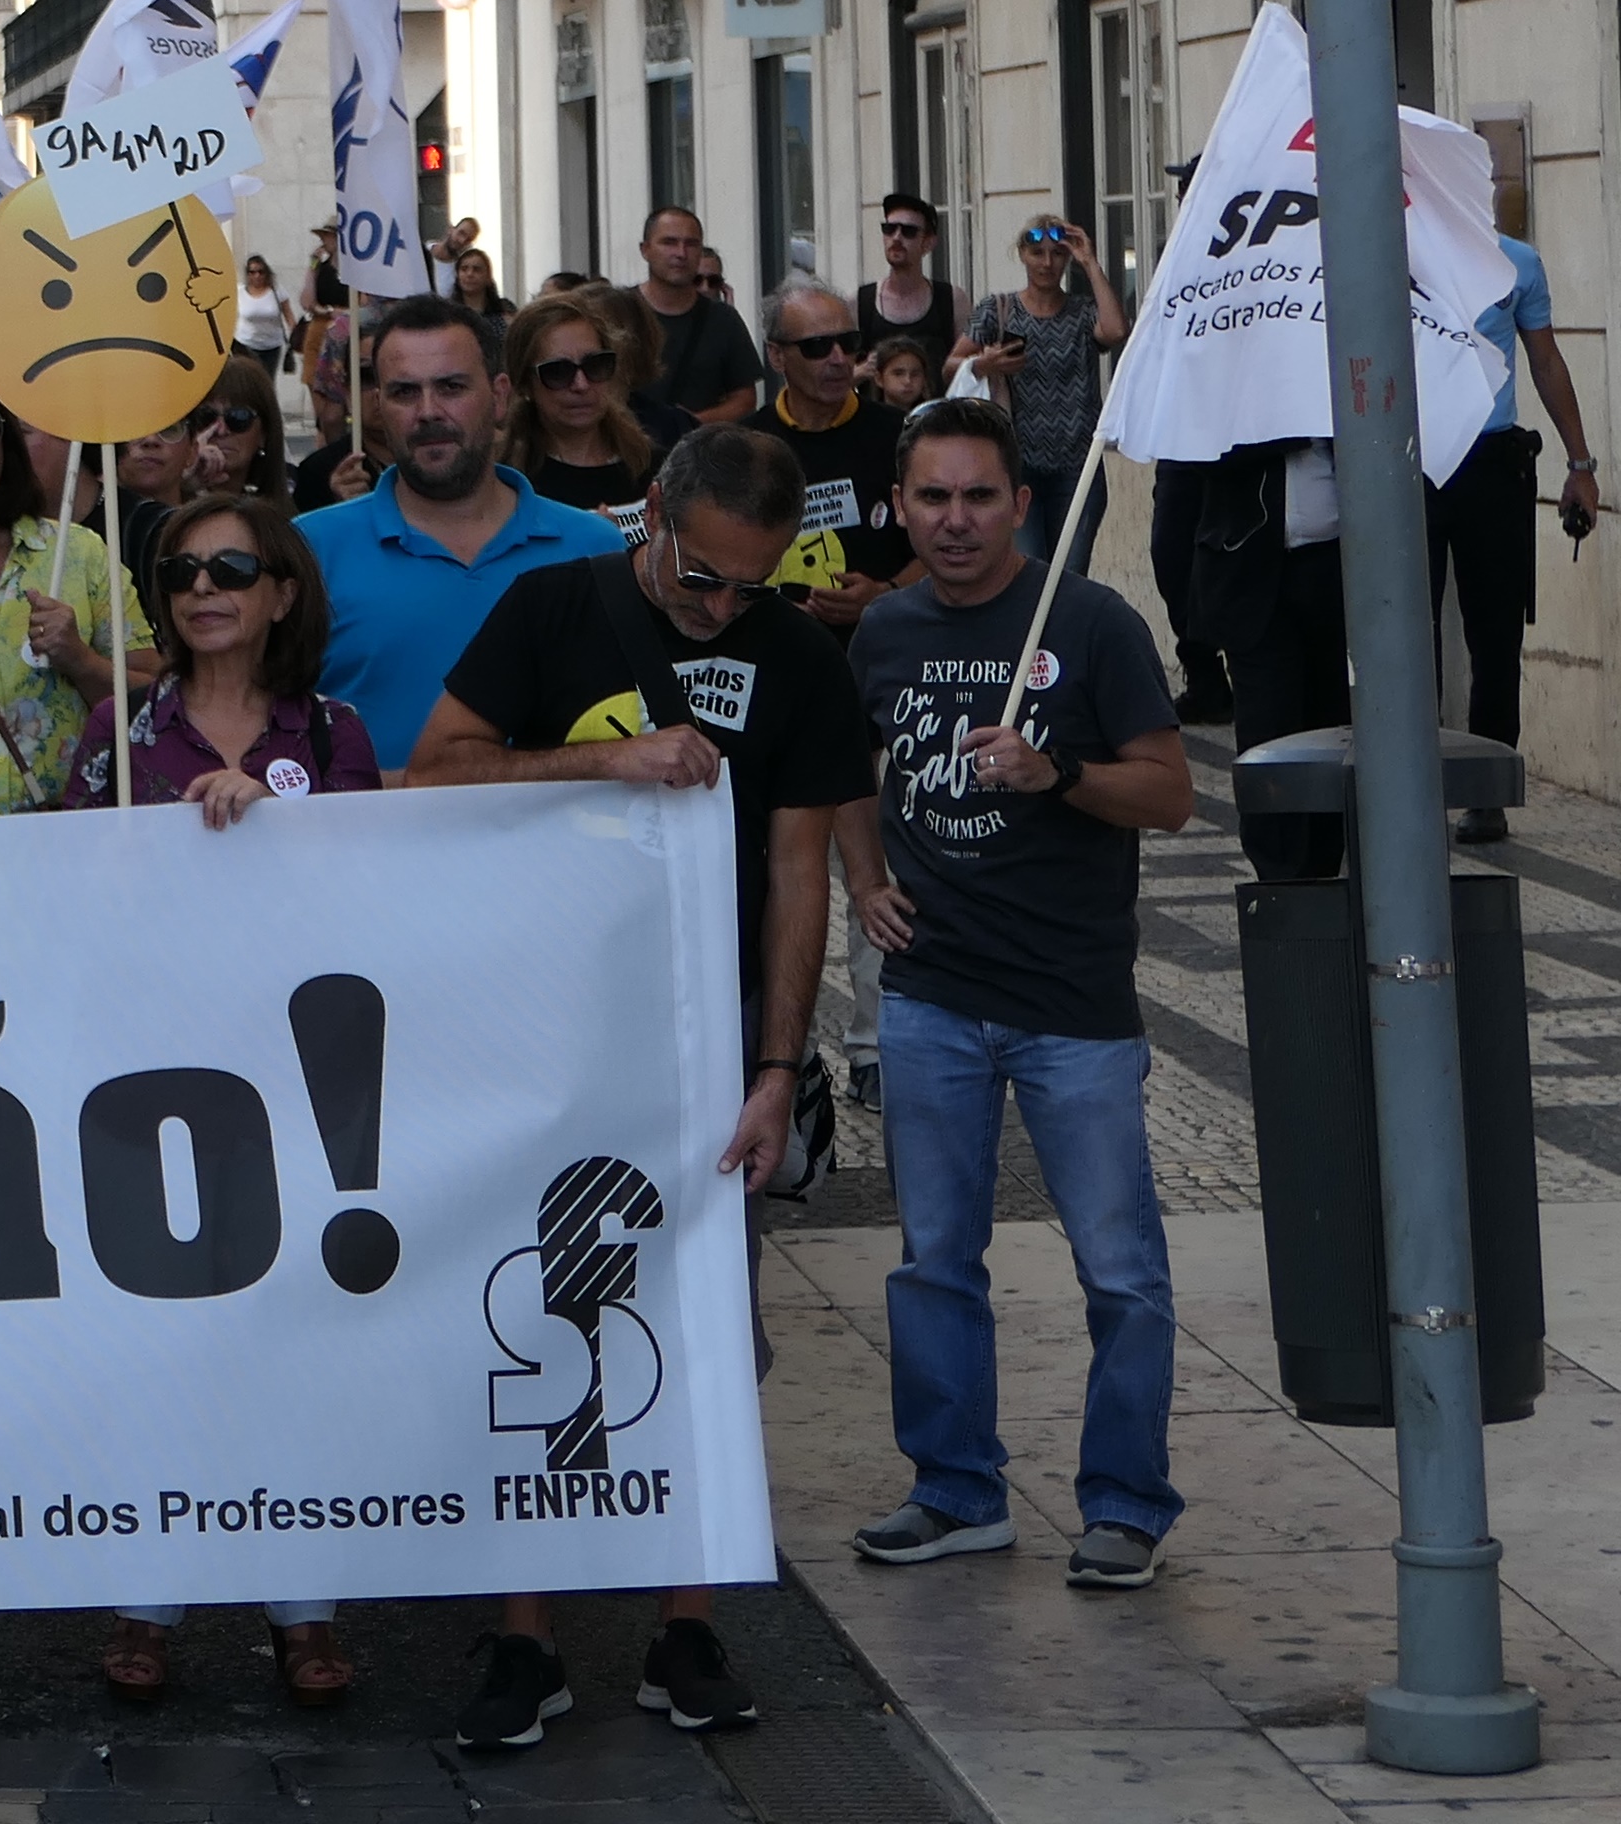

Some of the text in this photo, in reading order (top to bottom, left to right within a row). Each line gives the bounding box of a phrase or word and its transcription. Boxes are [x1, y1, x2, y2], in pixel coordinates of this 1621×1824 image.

[1249, 258, 1303, 285] dos
[807, 484, 852, 502] NTAÇÃO?
[921, 660, 1011, 684] EXPLORE
[1031, 676, 1049, 687] 2D
[689, 691, 739, 719] eito
[893, 687, 935, 725] On
[915, 711, 942, 742] a
[924, 809, 1007, 840] SUMMER
[493, 1469, 673, 1524] FENPROF
[42, 1490, 141, 1539] dos
[159, 1484, 466, 1537] Professores
